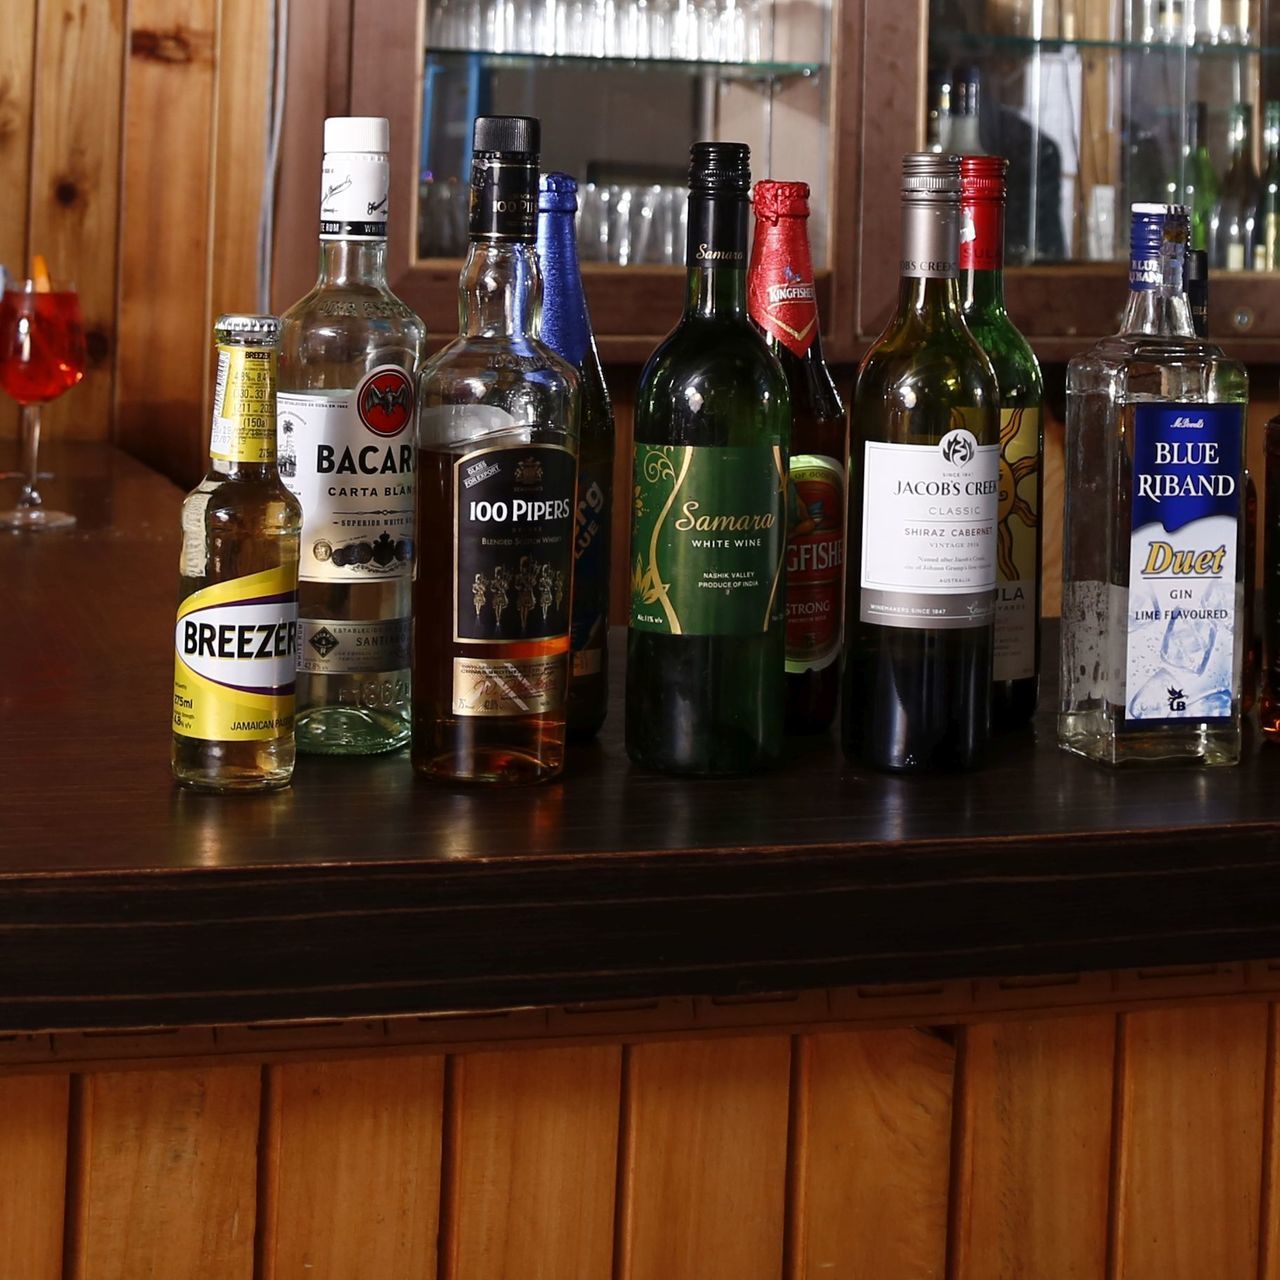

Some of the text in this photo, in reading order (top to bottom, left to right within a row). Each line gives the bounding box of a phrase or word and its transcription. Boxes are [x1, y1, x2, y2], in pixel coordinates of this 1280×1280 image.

[696, 243, 744, 260] Samara
[1155, 442, 1220, 465] BLUE
[328, 487, 378, 497] CARTA
[893, 479, 961, 497] JACOB'S
[1137, 474, 1235, 503] RIBAND
[469, 498, 570, 522] 100 PIPERS
[675, 500, 776, 533] Samara
[928, 506, 981, 516] CLASSIC
[904, 526, 993, 538] SHIRAZ CABERNET
[691, 537, 762, 549] WHITE WINE
[1141, 540, 1226, 575] Duet
[698, 581, 732, 589] PRODUCE
[742, 580, 759, 588] INDIA
[1170, 589, 1193, 600] GIN
[785, 599, 831, 617] STRONG
[870, 604, 910, 614] WINEMAKERS
[1135, 609, 1228, 621] LIME FLAVOURED
[184, 620, 297, 659] BREEZER
[230, 719, 274, 731] JAMAICAN
